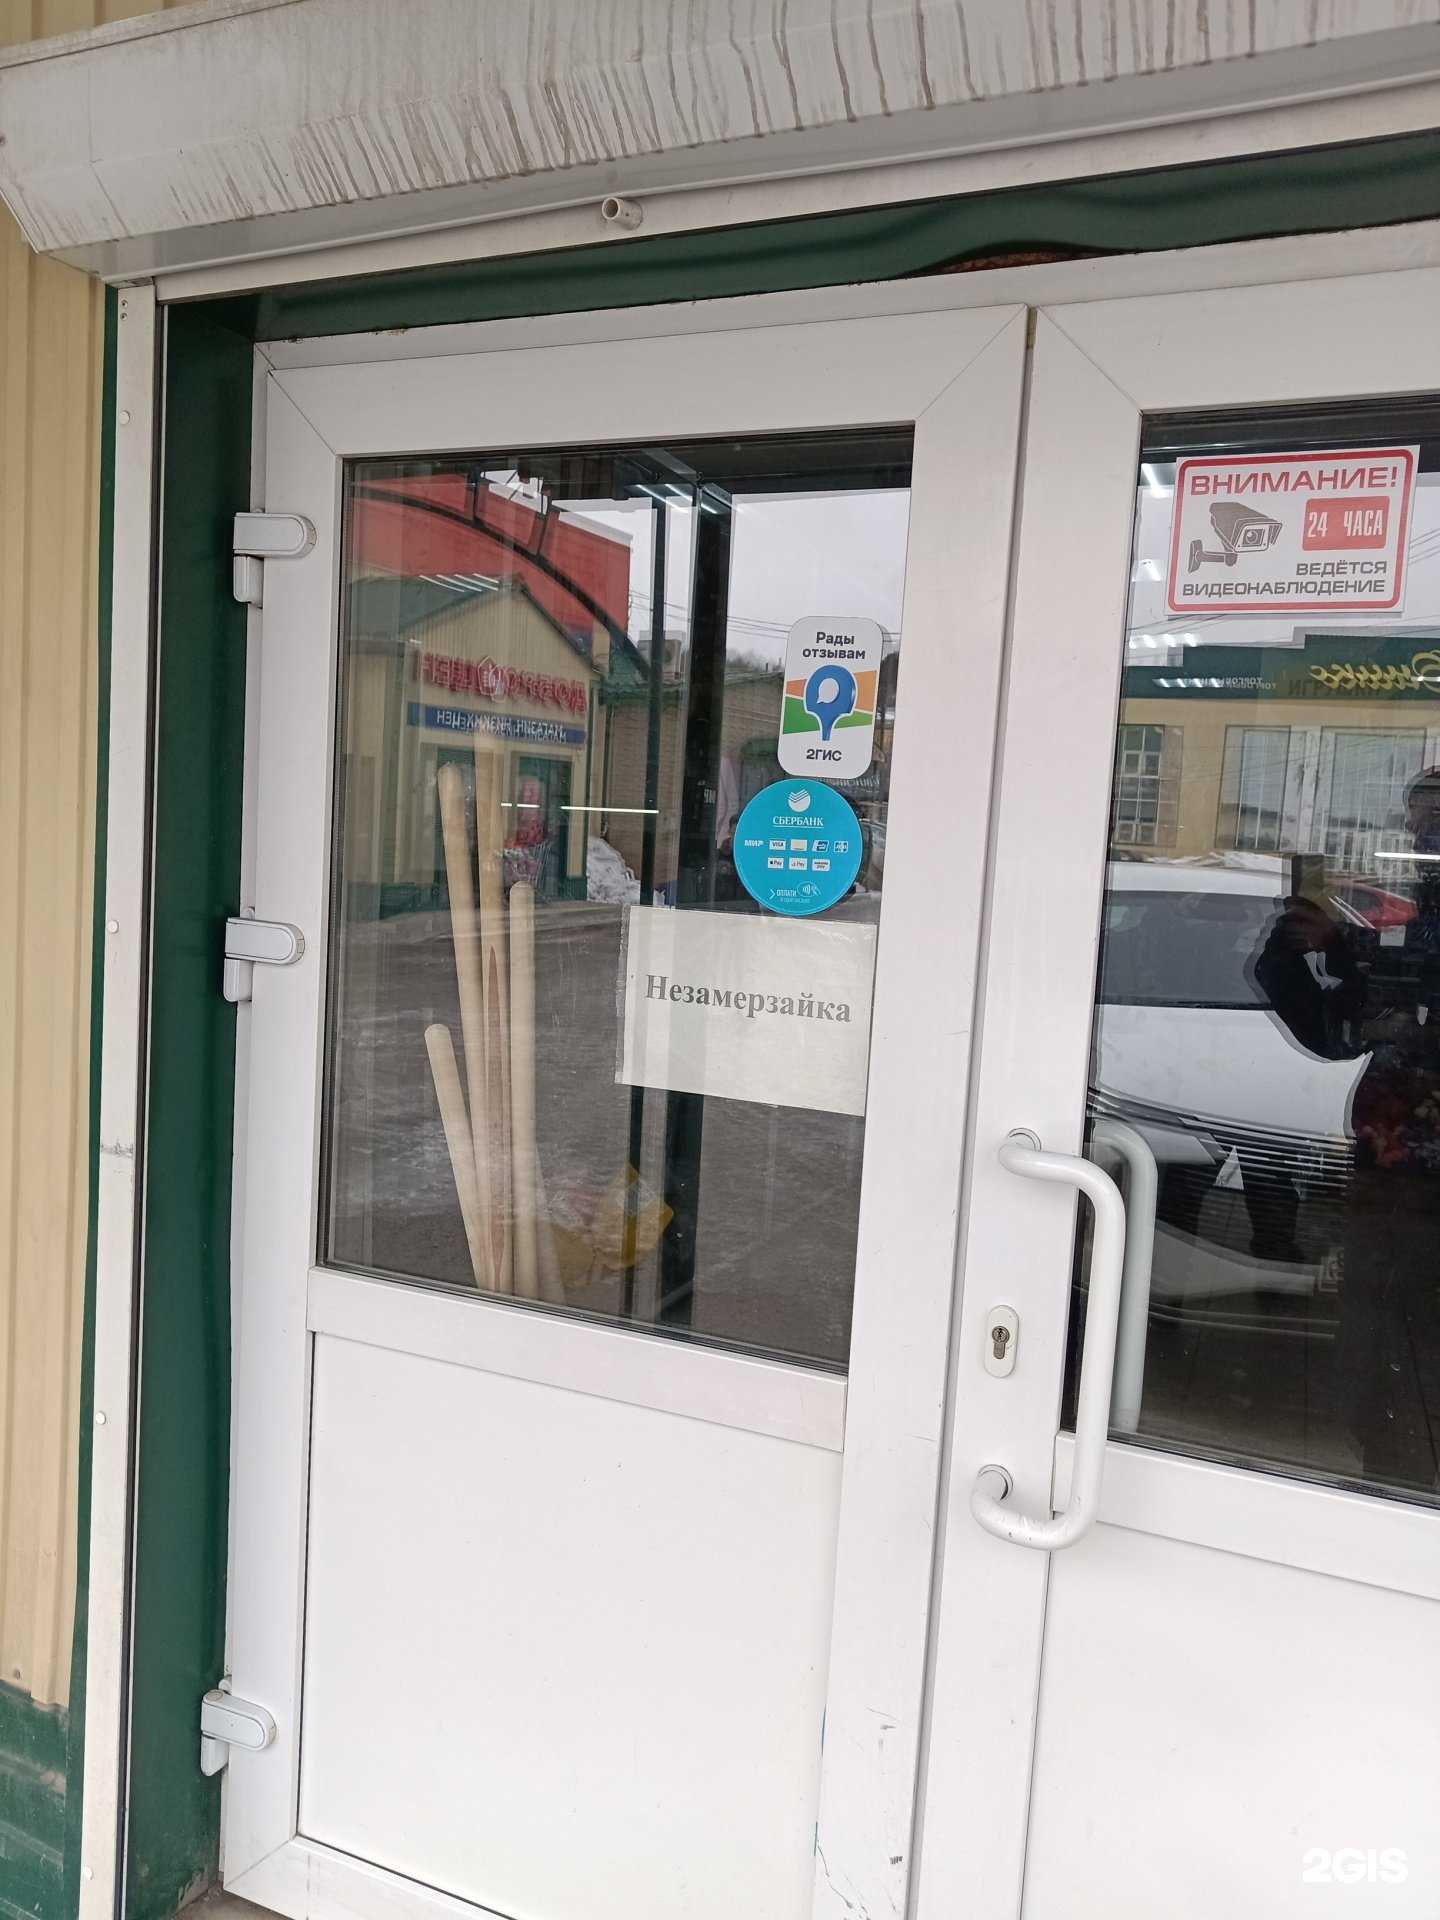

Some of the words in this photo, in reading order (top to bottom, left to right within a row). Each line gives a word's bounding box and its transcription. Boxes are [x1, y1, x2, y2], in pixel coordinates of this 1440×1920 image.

[1190, 466, 1398, 496] ВНИМАНИЕ!
[1307, 513, 1328, 538] 24
[1343, 509, 1383, 537] ЧАСА
[1296, 560, 1387, 578] ВЕДЁТСЯ
[1182, 580, 1385, 598] ВИДЕОНАБЛЮДЕНИЕ
[816, 631, 855, 647] Рады
[802, 648, 866, 660] отзывам
[806, 749, 842, 762] 2ГИС
[772, 816, 824, 826] СБЕРБАНК
[646, 974, 852, 1022] Незамерзайка
